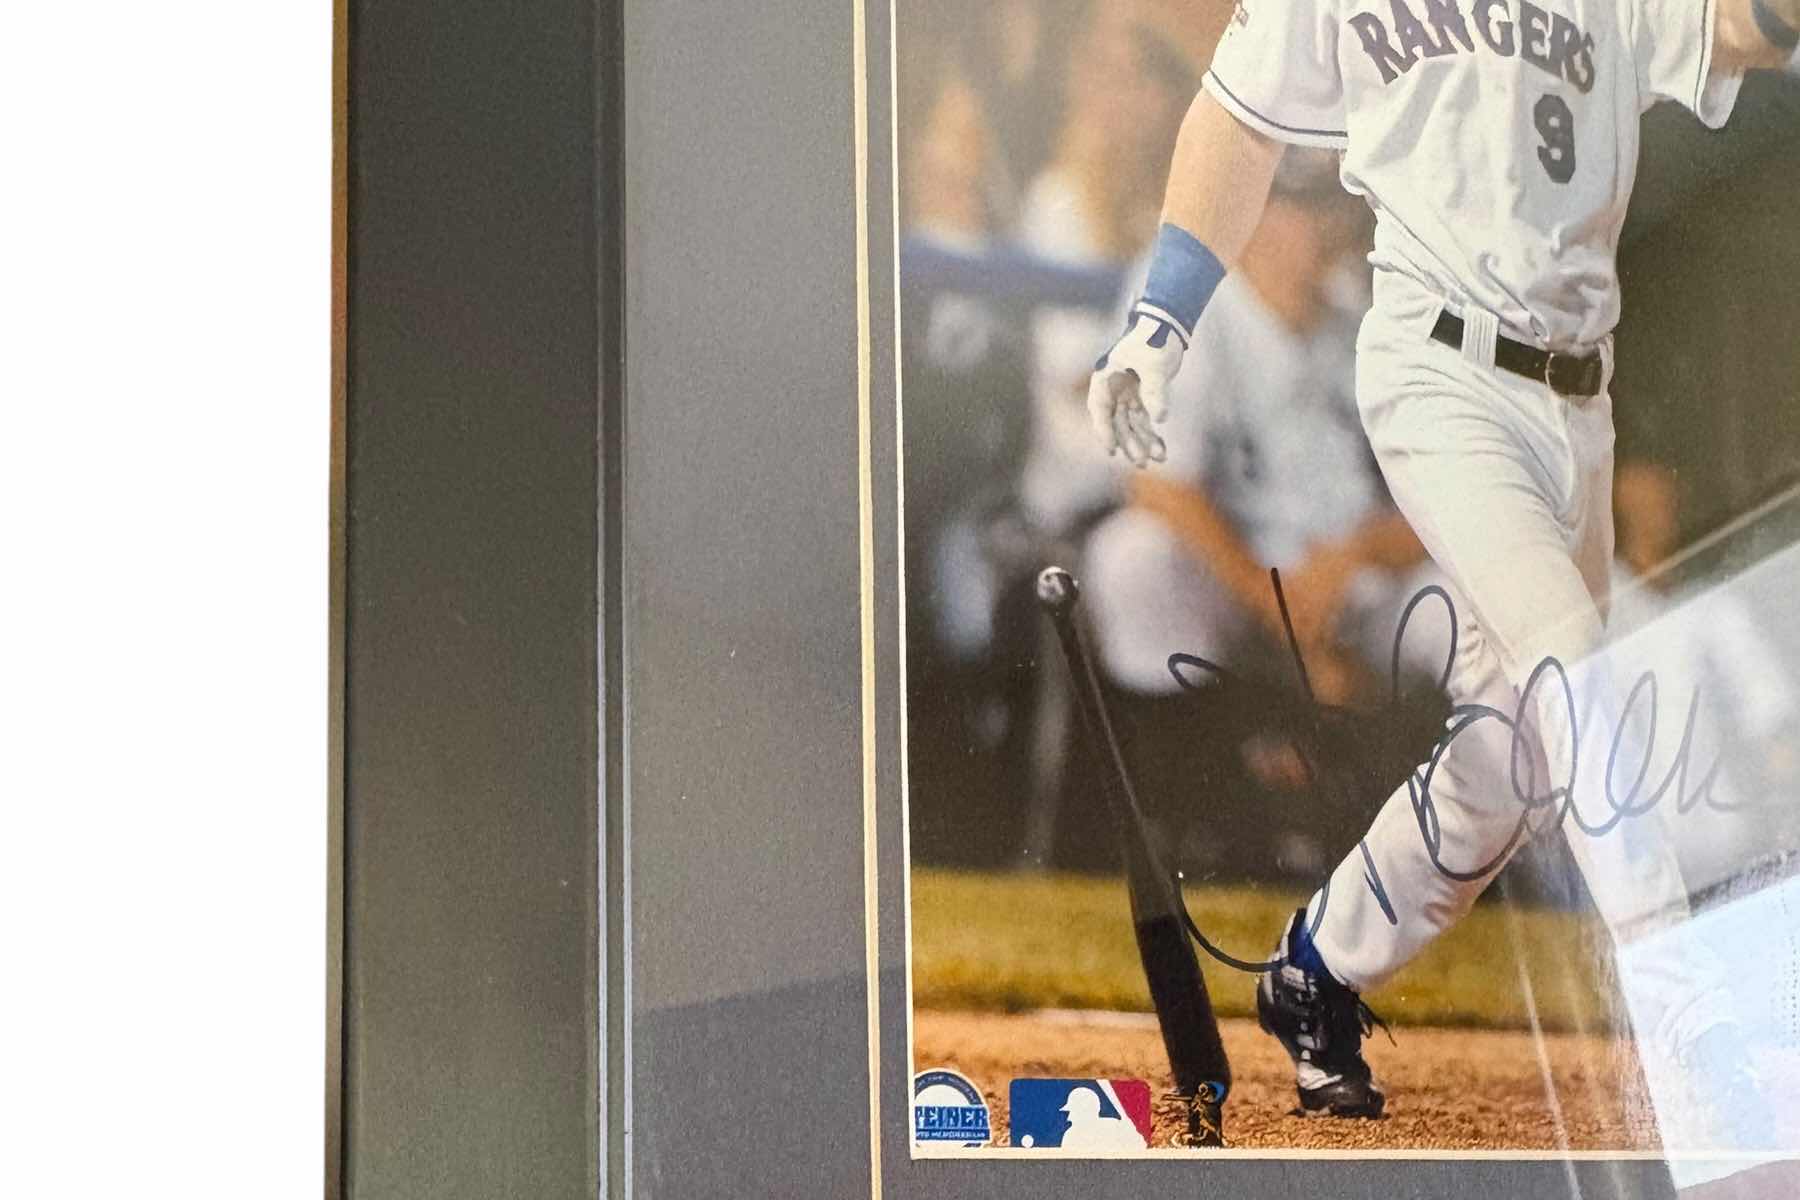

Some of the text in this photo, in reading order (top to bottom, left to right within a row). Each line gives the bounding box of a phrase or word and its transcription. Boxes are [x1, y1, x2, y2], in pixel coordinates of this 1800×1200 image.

[1347, 0, 1595, 94] RANGERS
[1533, 94, 1576, 184] 9
[914, 1106, 988, 1128] TEINER
